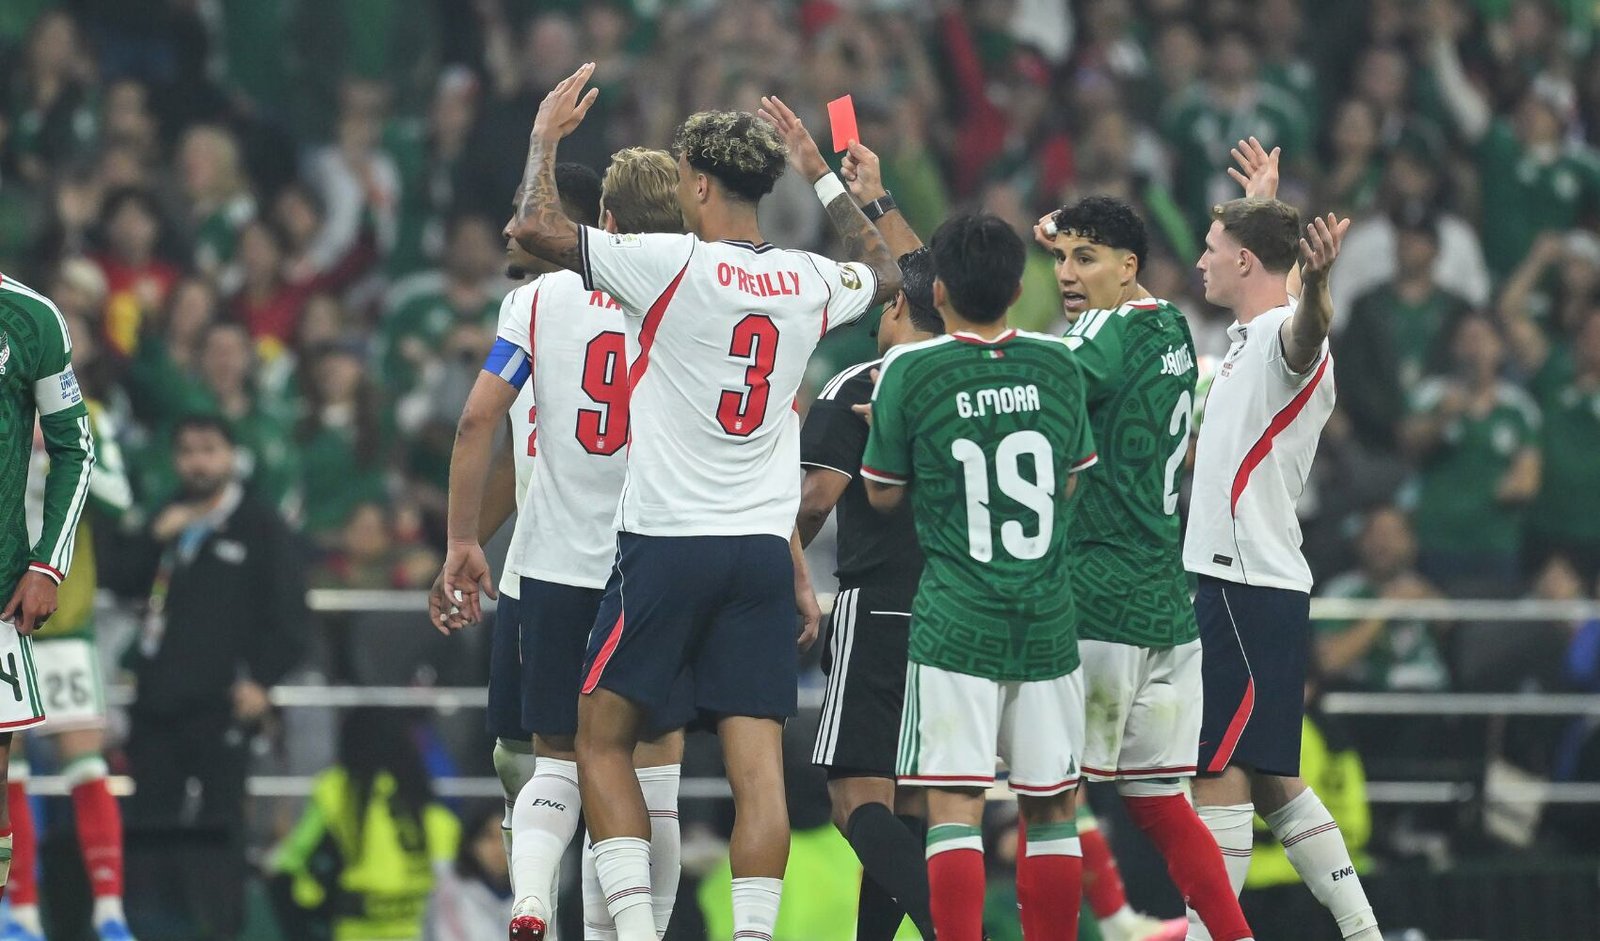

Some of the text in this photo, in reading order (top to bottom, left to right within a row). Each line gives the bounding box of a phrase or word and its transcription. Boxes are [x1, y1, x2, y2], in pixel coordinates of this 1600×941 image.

[717, 262, 800, 297] O'REILLY
[575, 330, 632, 456] 9
[715, 313, 780, 437] 3
[956, 384, 1040, 418] G.MORA
[1163, 389, 1192, 515] 2
[951, 430, 1055, 563] 19
[532, 798, 567, 811] ENG
[1331, 865, 1354, 881] ENG
